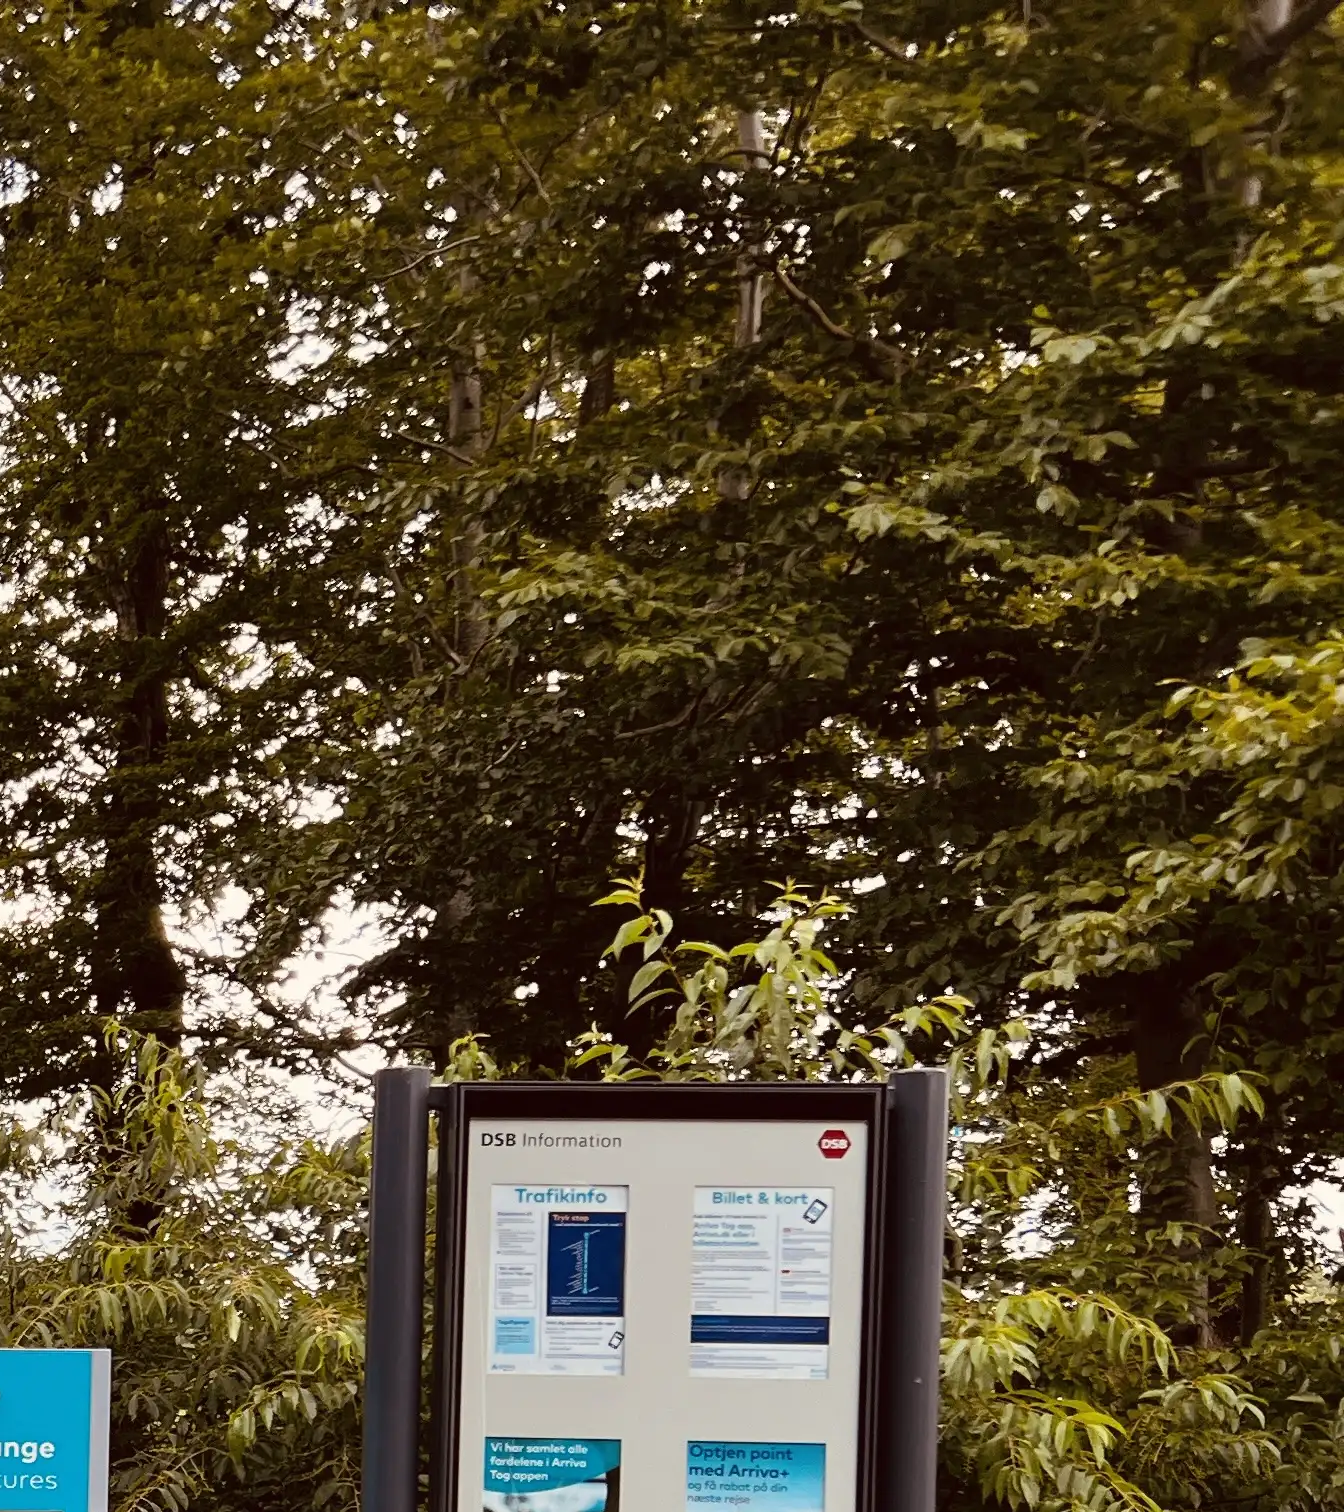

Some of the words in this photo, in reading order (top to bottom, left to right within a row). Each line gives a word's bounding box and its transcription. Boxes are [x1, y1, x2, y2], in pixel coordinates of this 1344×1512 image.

[480, 1132, 517, 1147] DSB
[522, 1132, 623, 1148] Information
[820, 1138, 849, 1150] DSB
[514, 1187, 608, 1204] Trafikinfo
[711, 1191, 753, 1205] Billet
[757, 1191, 769, 1205] &
[774, 1191, 809, 1205] kort
[490, 1442, 503, 1453] Vi
[504, 1442, 524, 1453] har
[526, 1443, 566, 1454] samlet
[567, 1444, 589, 1454] alle
[689, 1444, 746, 1461] Optjen
[750, 1446, 794, 1462] point
[489, 1456, 544, 1467] fordelene
[551, 1457, 587, 1468] Arriva
[489, 1469, 511, 1482] Tog
[512, 1472, 549, 1482] appen
[688, 1464, 724, 1476] med
[727, 1464, 790, 1479] Arriva+
[687, 1481, 702, 1492] og
[704, 1480, 717, 1490] få
[719, 1481, 751, 1492] rabat
[753, 1482, 767, 1493] på
[769, 1482, 788, 1493] din
[687, 1494, 721, 1504] næste
[723, 1495, 751, 1506] rejse
